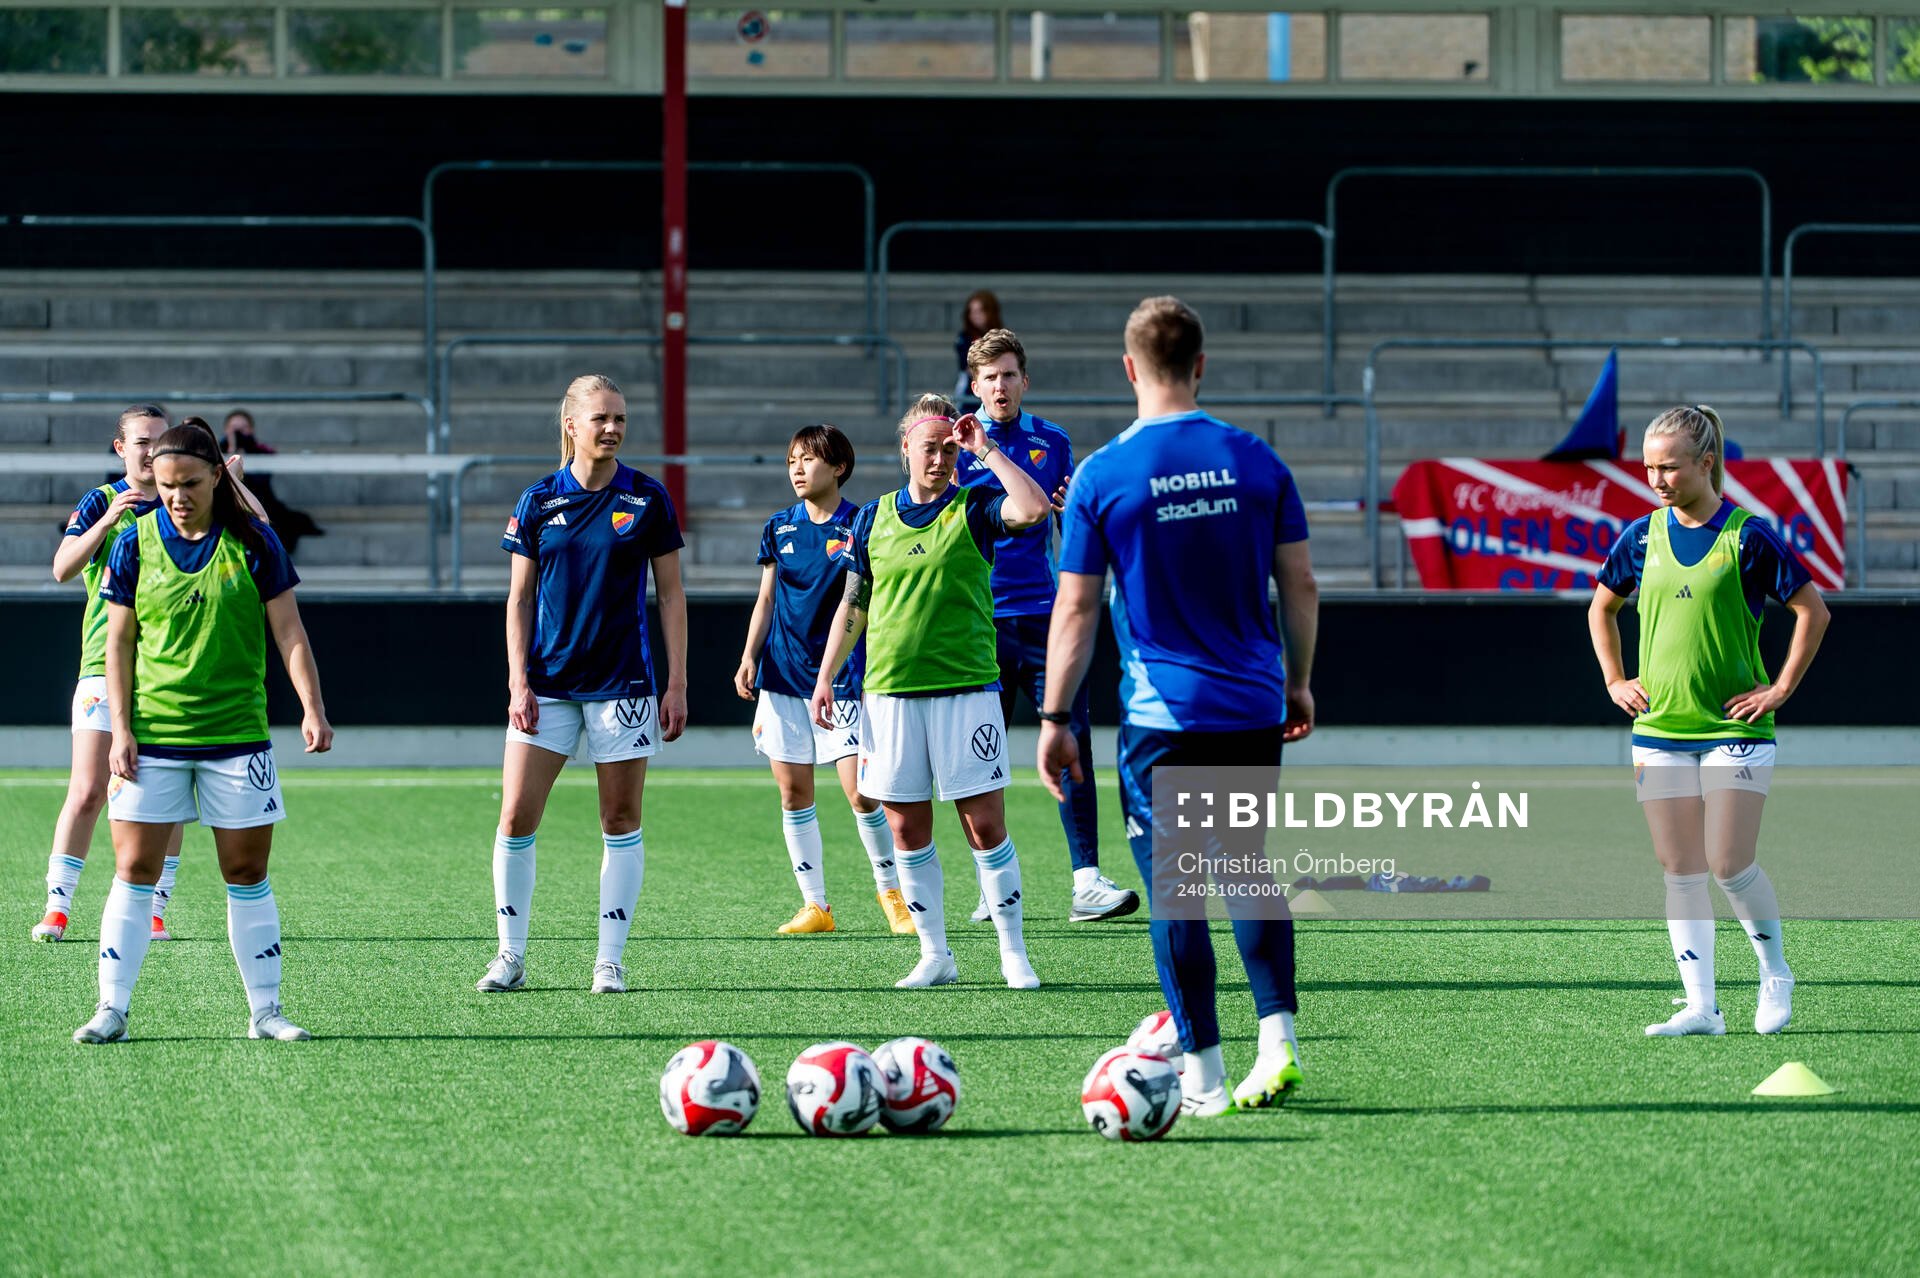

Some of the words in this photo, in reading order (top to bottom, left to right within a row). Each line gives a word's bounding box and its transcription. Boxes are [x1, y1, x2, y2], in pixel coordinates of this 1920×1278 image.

[1149, 468, 1237, 498] MOBILL
[1156, 497, 1238, 523] stadium
[1440, 515, 1551, 557] OLEN
[1564, 516, 1630, 556] SO
